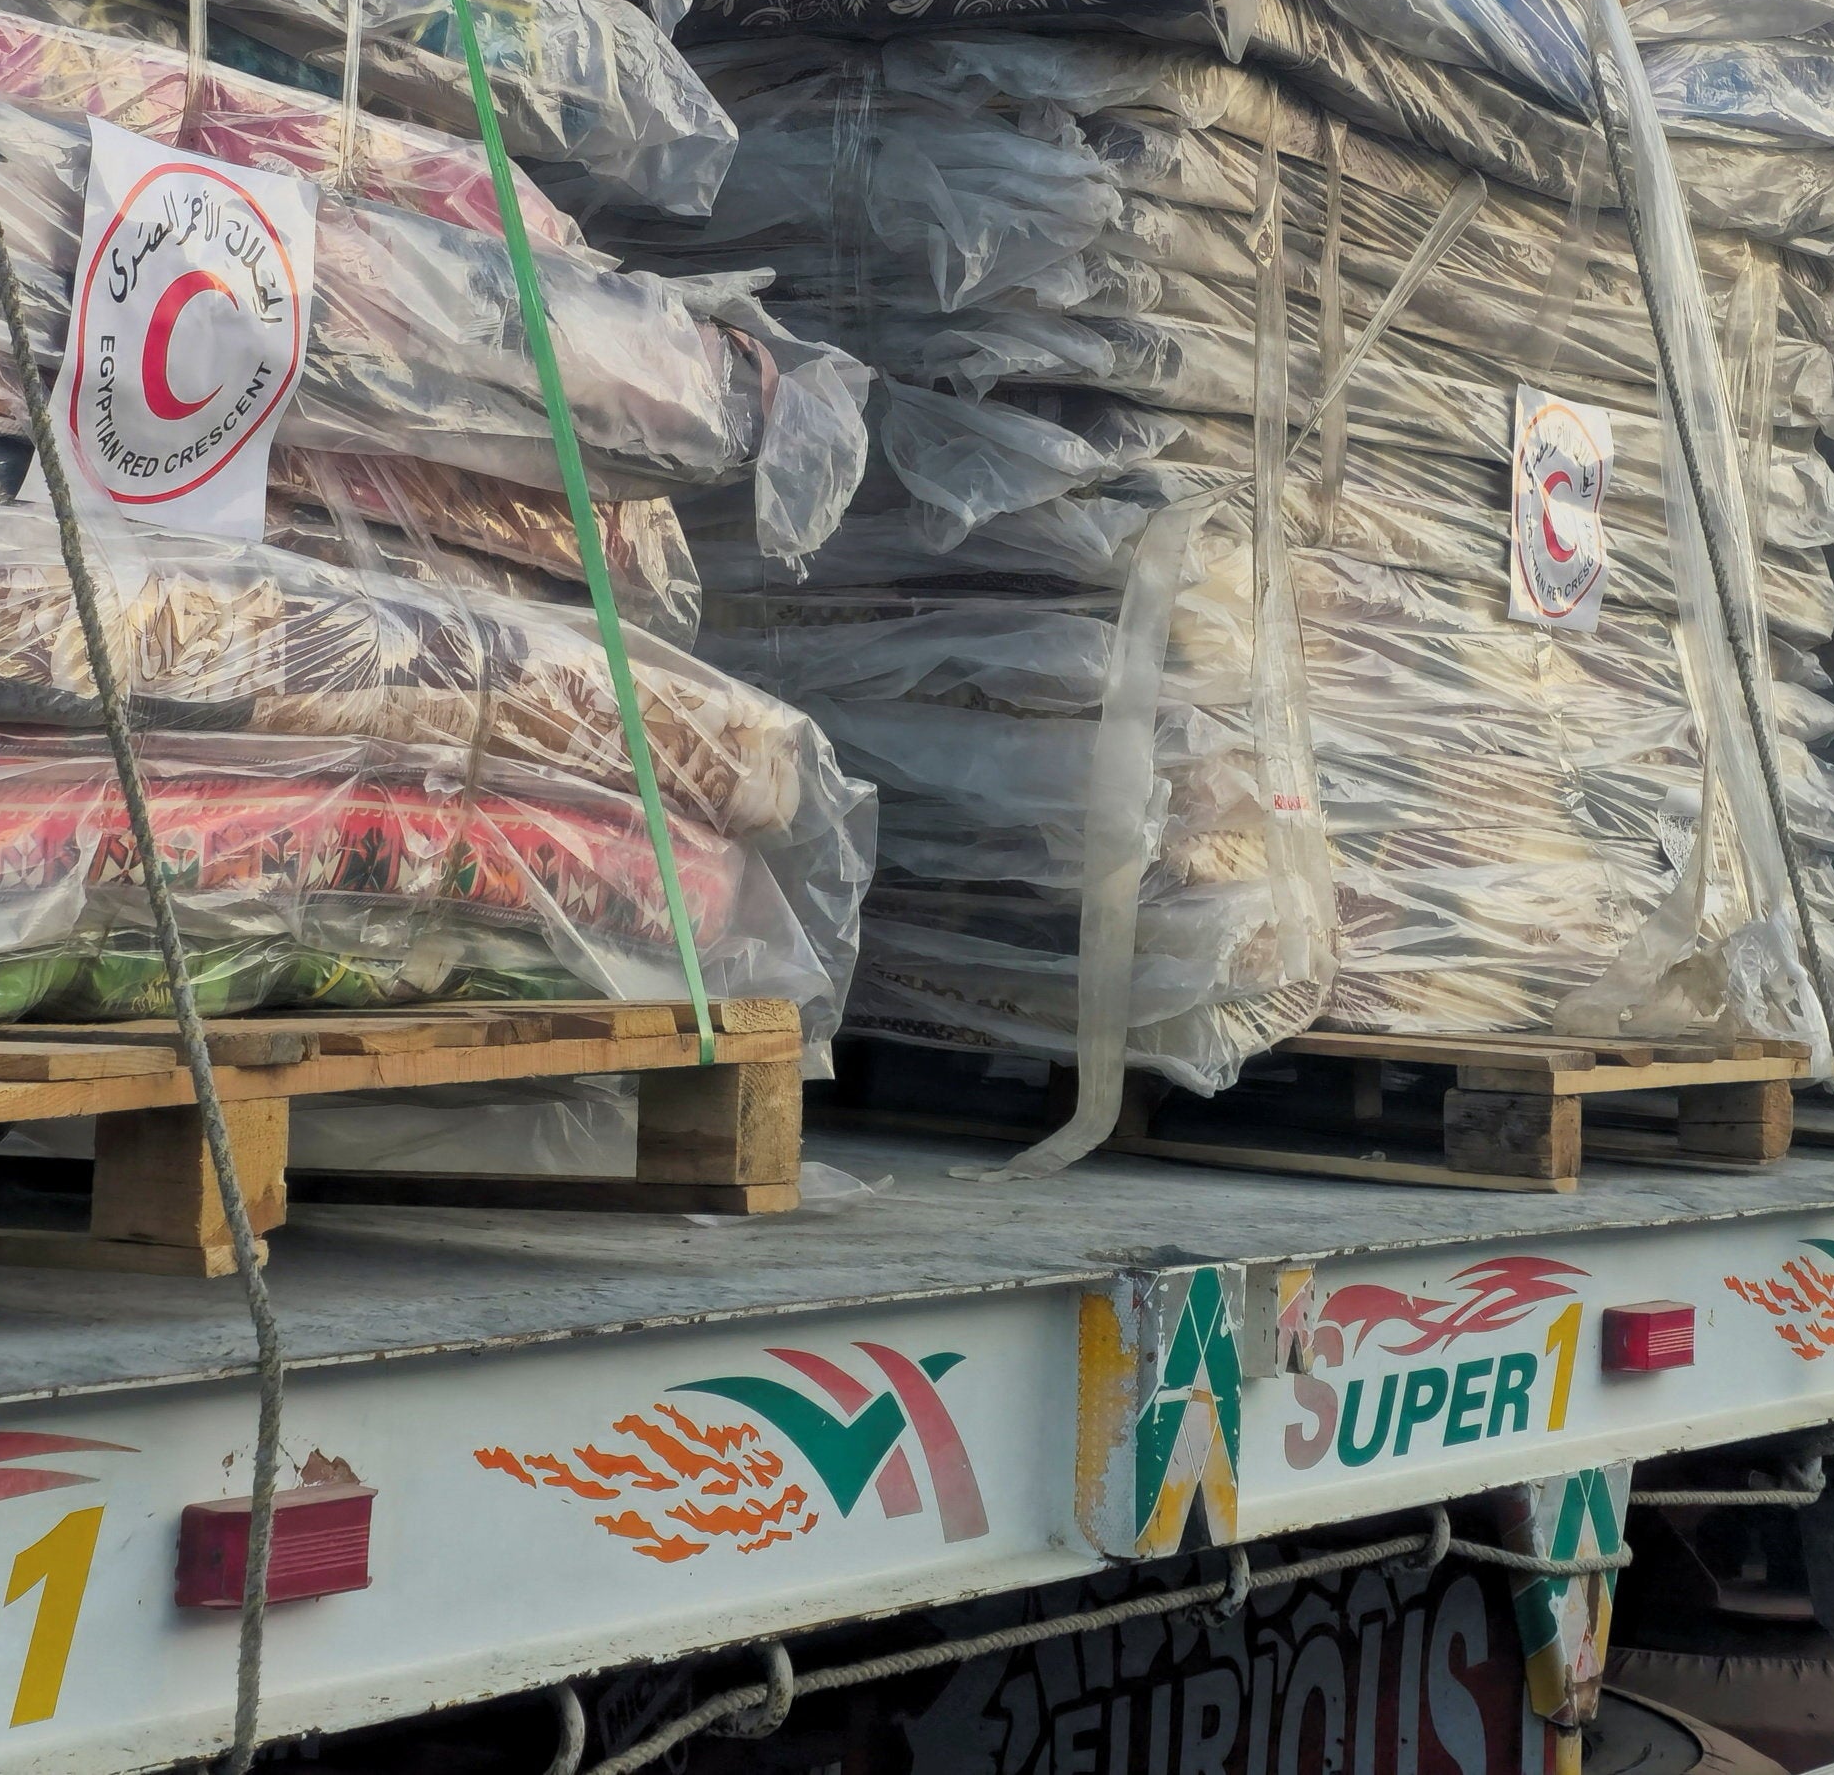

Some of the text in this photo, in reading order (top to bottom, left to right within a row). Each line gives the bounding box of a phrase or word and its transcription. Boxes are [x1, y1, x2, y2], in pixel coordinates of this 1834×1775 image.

[95, 335, 272, 478] EGYPTIAN RED CRESCENT
